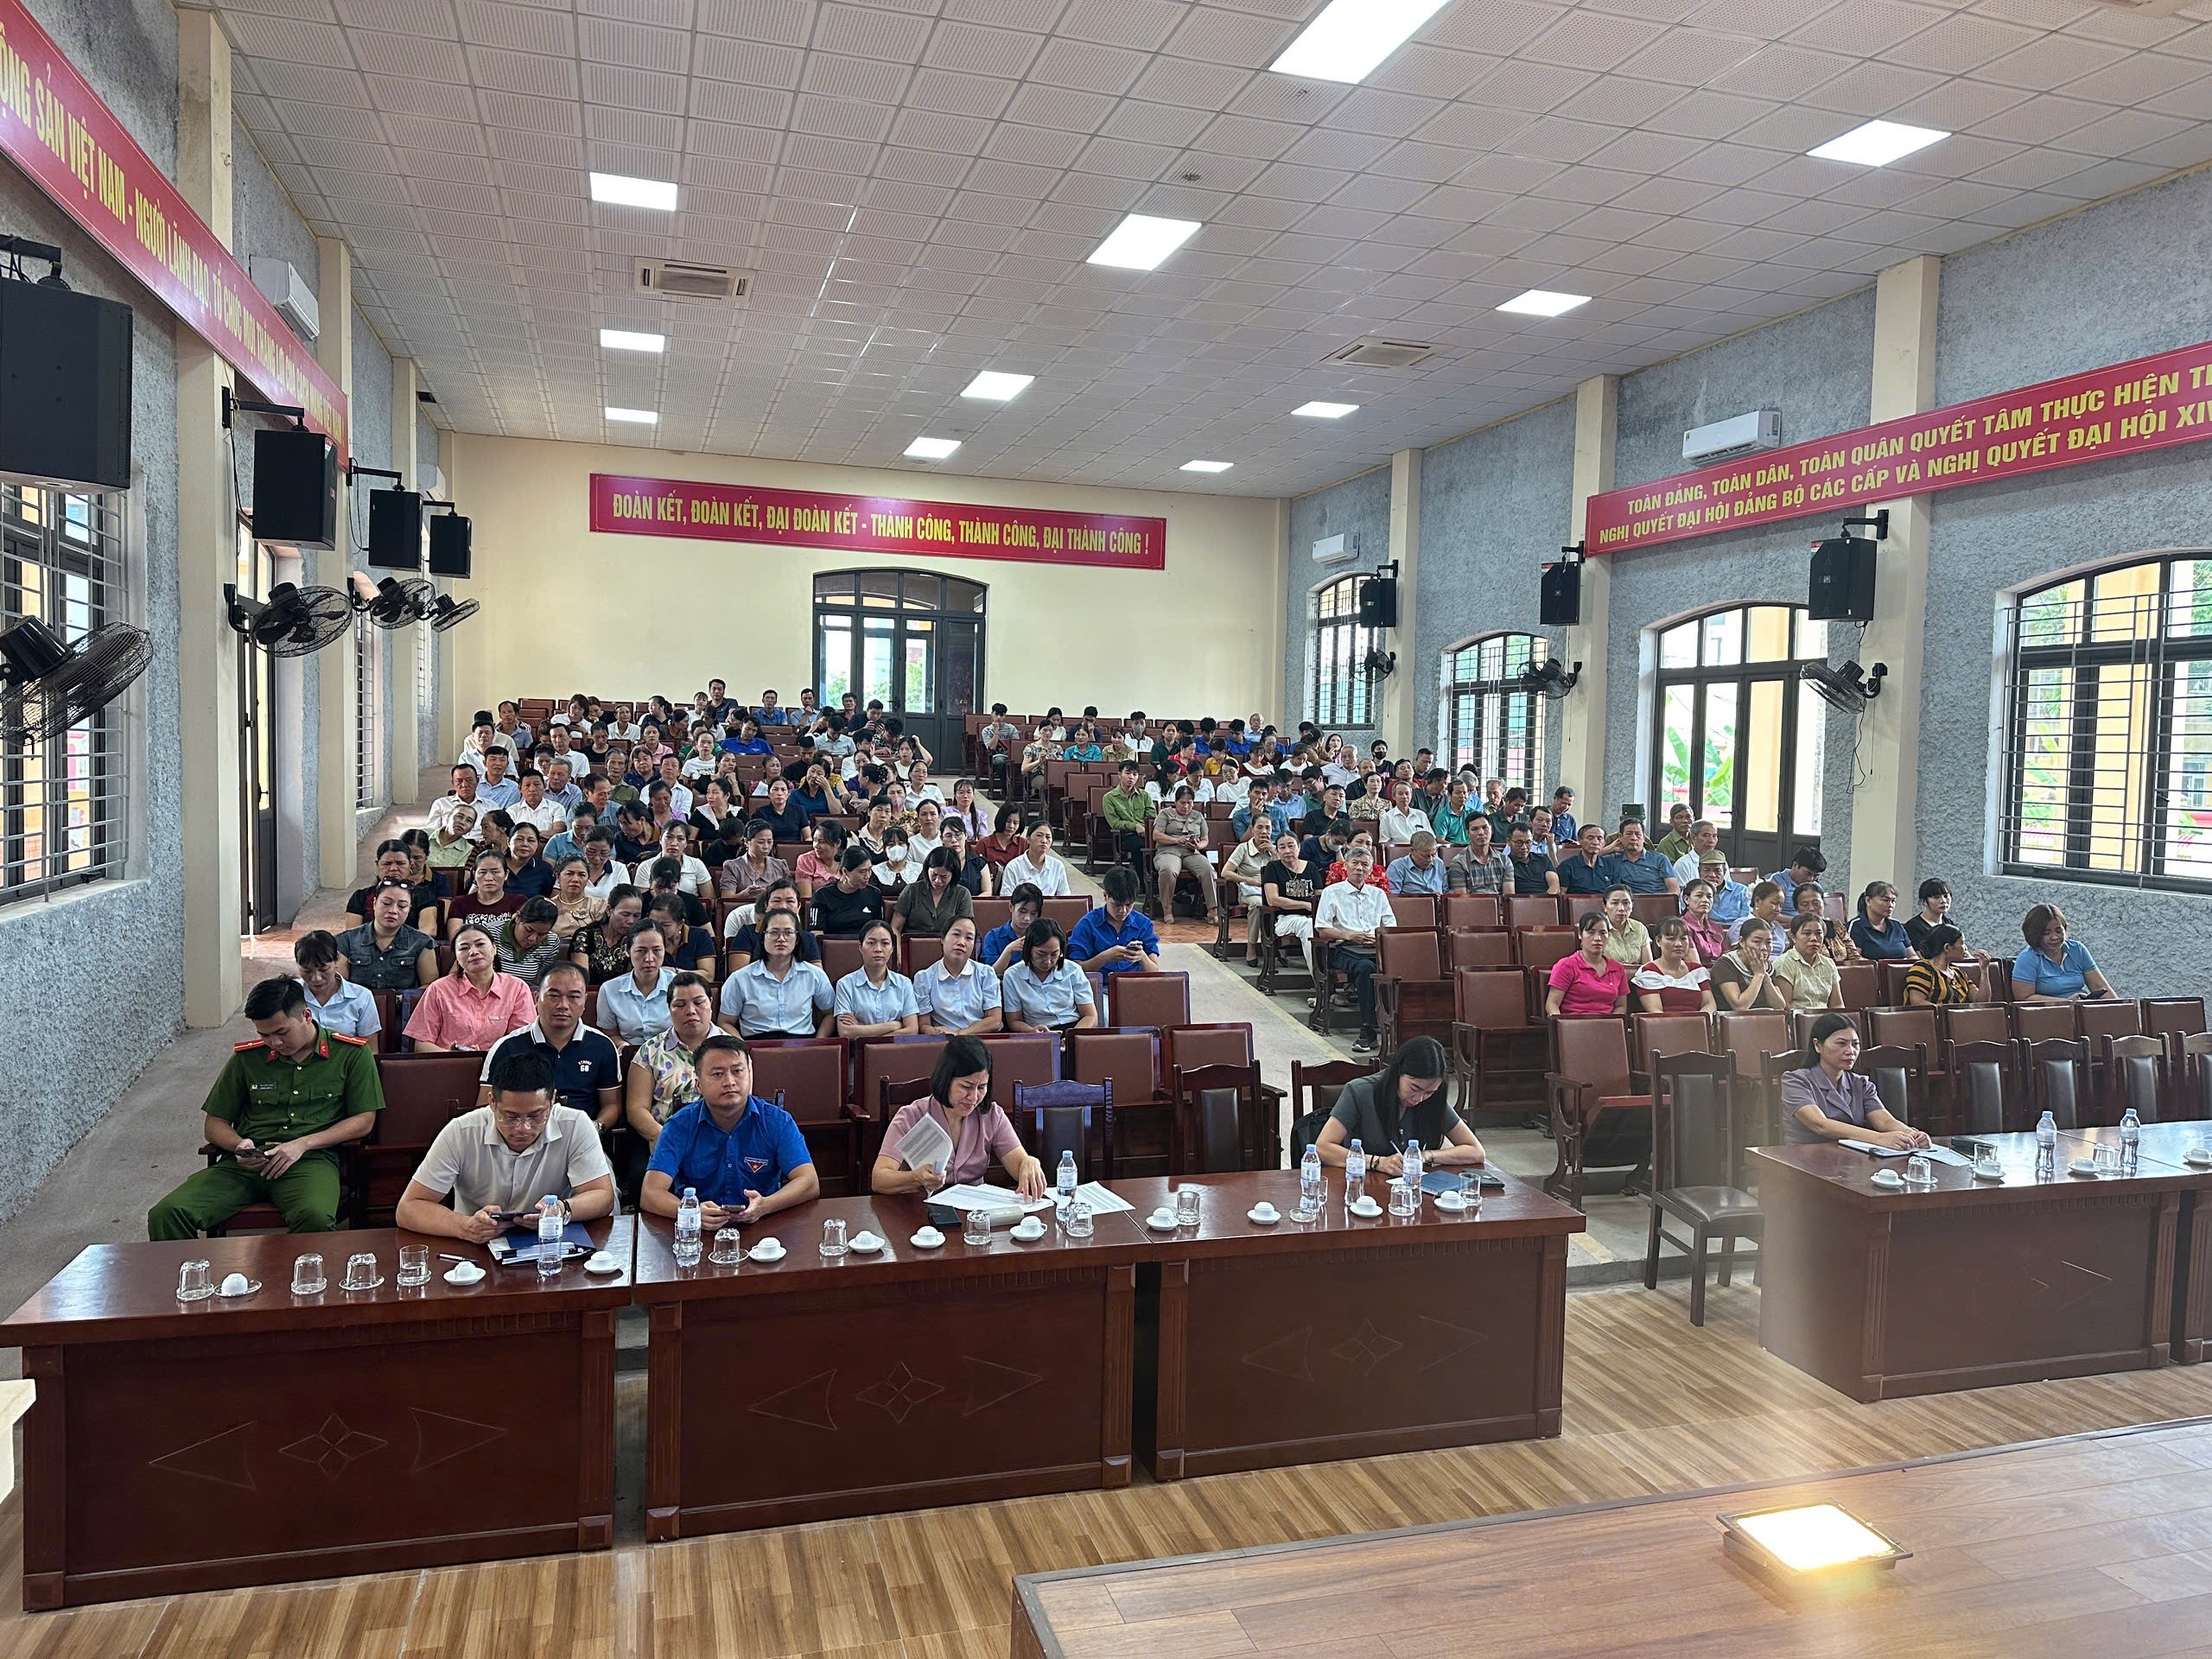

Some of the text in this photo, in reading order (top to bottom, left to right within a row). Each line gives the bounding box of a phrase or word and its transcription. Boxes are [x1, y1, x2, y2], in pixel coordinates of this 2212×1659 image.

[35, 62, 66, 163] SẢN
[68, 111, 95, 200] VIỆT
[99, 146, 126, 225] NAM
[135, 187, 167, 267] NGƯỜI
[168, 220, 192, 291] LÃNH
[213, 262, 222, 322] TỔ
[224, 283, 242, 342] CHỨC
[244, 306, 256, 363] MỌI
[1599, 524, 1630, 544] NGHỊ
[1633, 512, 1674, 537] QUYẾT
[1677, 508, 1701, 531] ĐẠI
[1705, 501, 1730, 525] HỘI
[1734, 491, 1777, 517] ĐẢNG
[1783, 484, 1805, 509] BỘ
[1810, 474, 1846, 502] CÁC
[1852, 464, 1890, 493] CẤP
[1895, 458, 1921, 485] VÀ
[1927, 449, 1979, 478] NGHỊ
[1986, 428, 2061, 466] QUYẾT
[2068, 422, 2112, 454] ĐẠI
[2120, 407, 2166, 440] HỘI
[1628, 493, 1662, 515] TOÀN
[1665, 483, 1707, 507] ĐẢNG,
[1712, 473, 1751, 496] TOÀN
[1755, 464, 1794, 486] DÂN,
[1800, 450, 1845, 476] TOÀN
[1852, 435, 1904, 466] QUÂN
[1910, 415, 1977, 452] QUYẾT
[1982, 408, 2032, 435] TÂM
[2040, 390, 2105, 423] THỰC
[2113, 372, 2180, 408] HIỆN
[613, 491, 652, 520] ĐOÀN
[657, 490, 687, 525] KẾT,
[691, 496, 729, 525] ĐOÀN
[734, 495, 762, 531] KẾT,
[766, 505, 789, 534] ĐẠI
[793, 504, 830, 533] ĐOÀN
[834, 504, 858, 535] KẾT
[871, 510, 912, 538] THÀNH
[917, 513, 955, 544] CÔNG,
[958, 517, 999, 545] THÀNH
[1002, 519, 1039, 550] CÔNG,
[1043, 526, 1064, 554] ĐẠI
[1067, 524, 1105, 552] THÀNH
[1109, 527, 1141, 555] CÔNG
